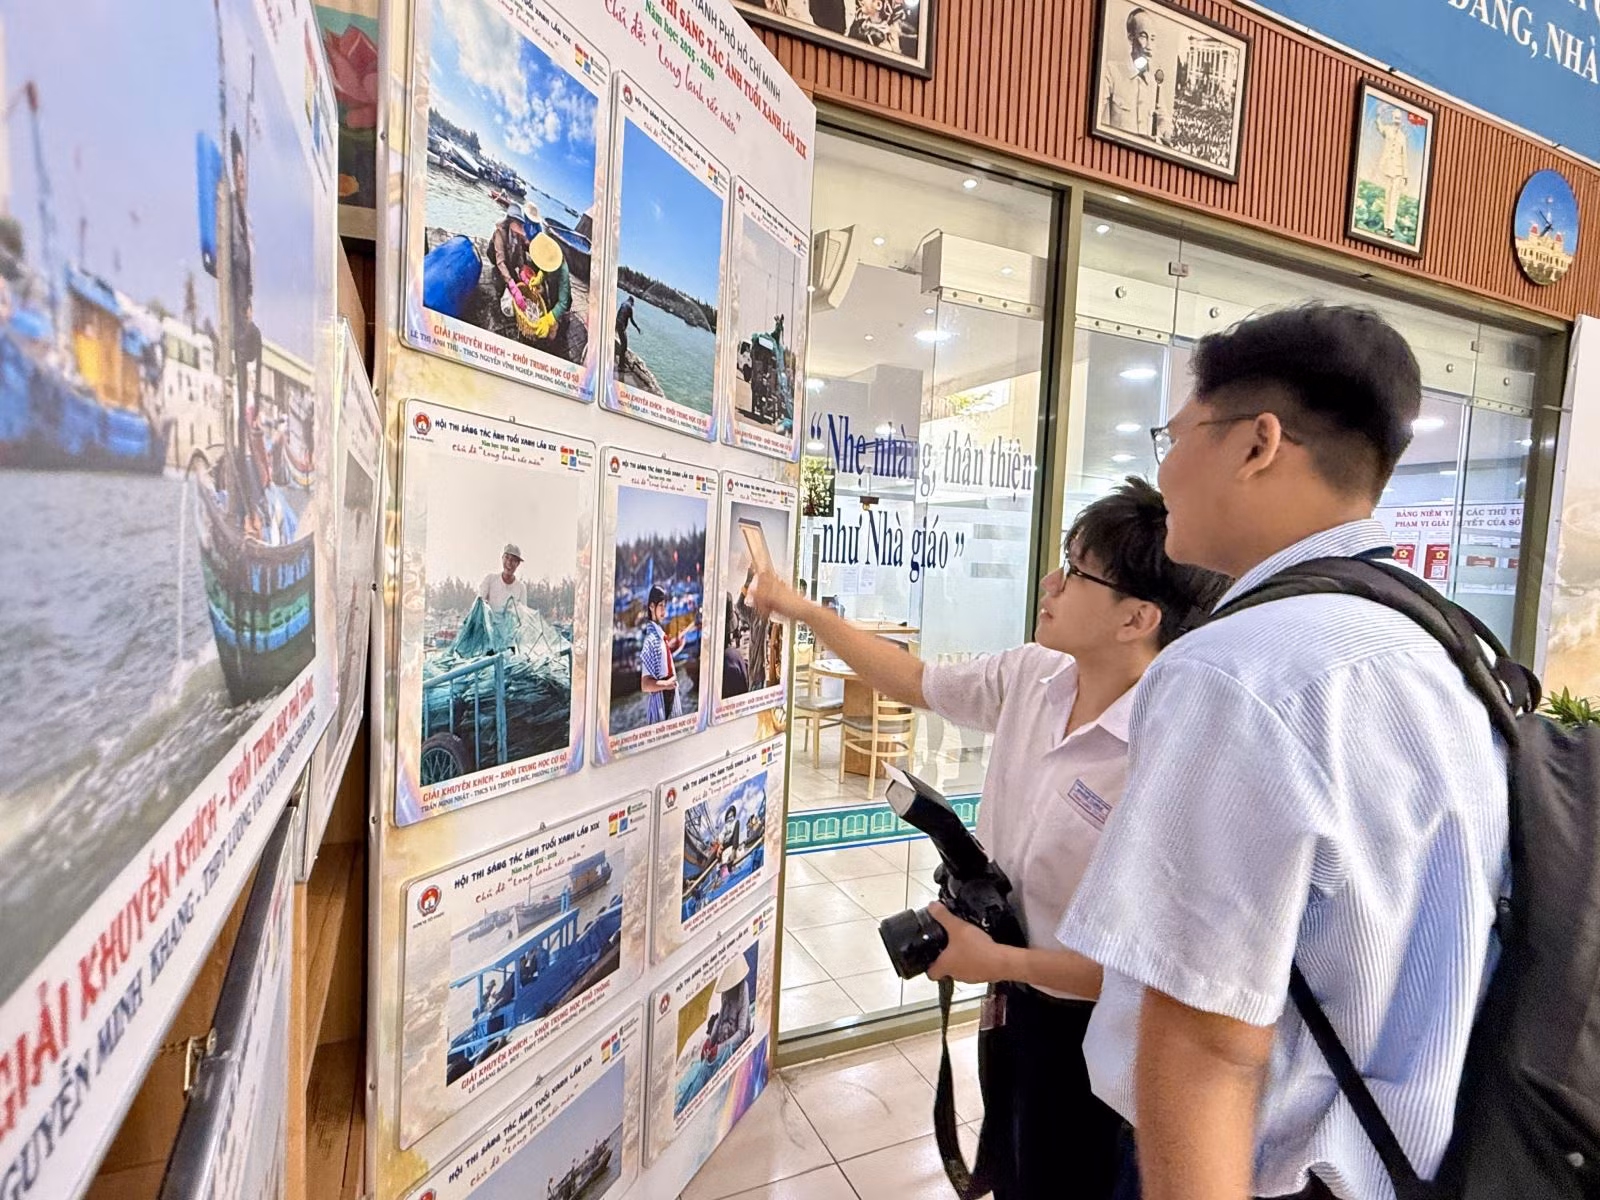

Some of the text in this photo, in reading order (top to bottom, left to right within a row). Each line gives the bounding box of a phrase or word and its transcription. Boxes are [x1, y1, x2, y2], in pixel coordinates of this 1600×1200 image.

[645, 0, 714, 81] Năm học: 2025 2026
[719, 18, 735, 48] PHỐ
[737, 40, 747, 64] HỒ
[749, 56, 761, 80] CHÍ
[762, 71, 780, 103] MINH
[1544, 22, 1599, 84] NHÀ
[680, 12, 705, 48] SÁNG
[707, 38, 724, 69] TÁC
[726, 60, 742, 90] ẢNH
[744, 79, 761, 111] TUỔI
[762, 101, 782, 133] XANH
[796, 137, 807, 160] XIX
[686, 63, 703, 104] lanh
[410, 329, 418, 339] LÊ
[420, 332, 431, 344] THỊ
[463, 347, 478, 358] THCS
[480, 349, 501, 366] NGUYỄN
[434, 325, 579, 383] GIẢI KHUYẾN KHÍCH KHỐI TRUNG HỌC CƠ SỞ
[435, 418, 446, 430] HỘI
[449, 422, 460, 432] THI
[461, 424, 478, 435] SÁNG
[480, 429, 490, 438] TÁC
[492, 431, 504, 441] ẢNH
[507, 433, 519, 444] TUỔI
[520, 438, 535, 447] XANH
[548, 444, 556, 452] XIX
[944, 430, 984, 486] thân
[989, 434, 1032, 502] thiện
[821, 507, 863, 564] như
[866, 510, 904, 567] Nhà
[1396, 509, 1418, 518] BẢNG
[1420, 508, 1442, 517] NIÊM
[1466, 508, 1485, 516] CÁC
[1488, 506, 1507, 516] THỦ
[1421, 520, 1430, 528] VI
[1487, 517, 1507, 527] CỦA
[421, 802, 437, 813] TRẦN
[438, 798, 453, 808] MINH
[474, 787, 488, 796] THCS
[489, 784, 497, 792] VÀ
[498, 780, 511, 789] THPT
[423, 752, 567, 802] GIẢI KHUYẾN KHÍCH KHỐI TRUNG HỌC CƠ SỞ
[79, 848, 171, 1021] KHUYẾN
[175, 793, 217, 887] KHÍCH
[228, 743, 251, 811] KHỐI
[253, 722, 276, 776] TRUNG
[454, 874, 468, 889] HỘI
[471, 869, 484, 881] THI
[486, 860, 506, 876] SÁNG
[508, 852, 522, 866] TÁC
[524, 846, 538, 859] ẢNH
[541, 836, 556, 852] TUỔI
[558, 832, 574, 845] XANH
[590, 821, 599, 832] XIX
[476, 889, 493, 903] Chủ
[96, 966, 143, 1076] MINH
[150, 888, 195, 986] KHANG
[461, 1072, 477, 1090] GIẢI
[478, 1047, 506, 1078] KHUYẾN
[508, 1036, 528, 1056] KHÍCH
[534, 1020, 549, 1038] KHỐI
[550, 1008, 569, 1026] TRUNG
[570, 1000, 581, 1013] HỌC
[582, 988, 593, 1004] PHỔ
[449, 1165, 462, 1183] HỘI
[466, 1152, 478, 1168] THI
[481, 1133, 500, 1156] SÁNG
[504, 1119, 517, 1136] TÁC
[518, 1106, 532, 1123] ẢNH
[535, 1090, 550, 1109] TUỔI
[552, 1076, 568, 1095] XANH
[582, 1055, 592, 1069] XIX
